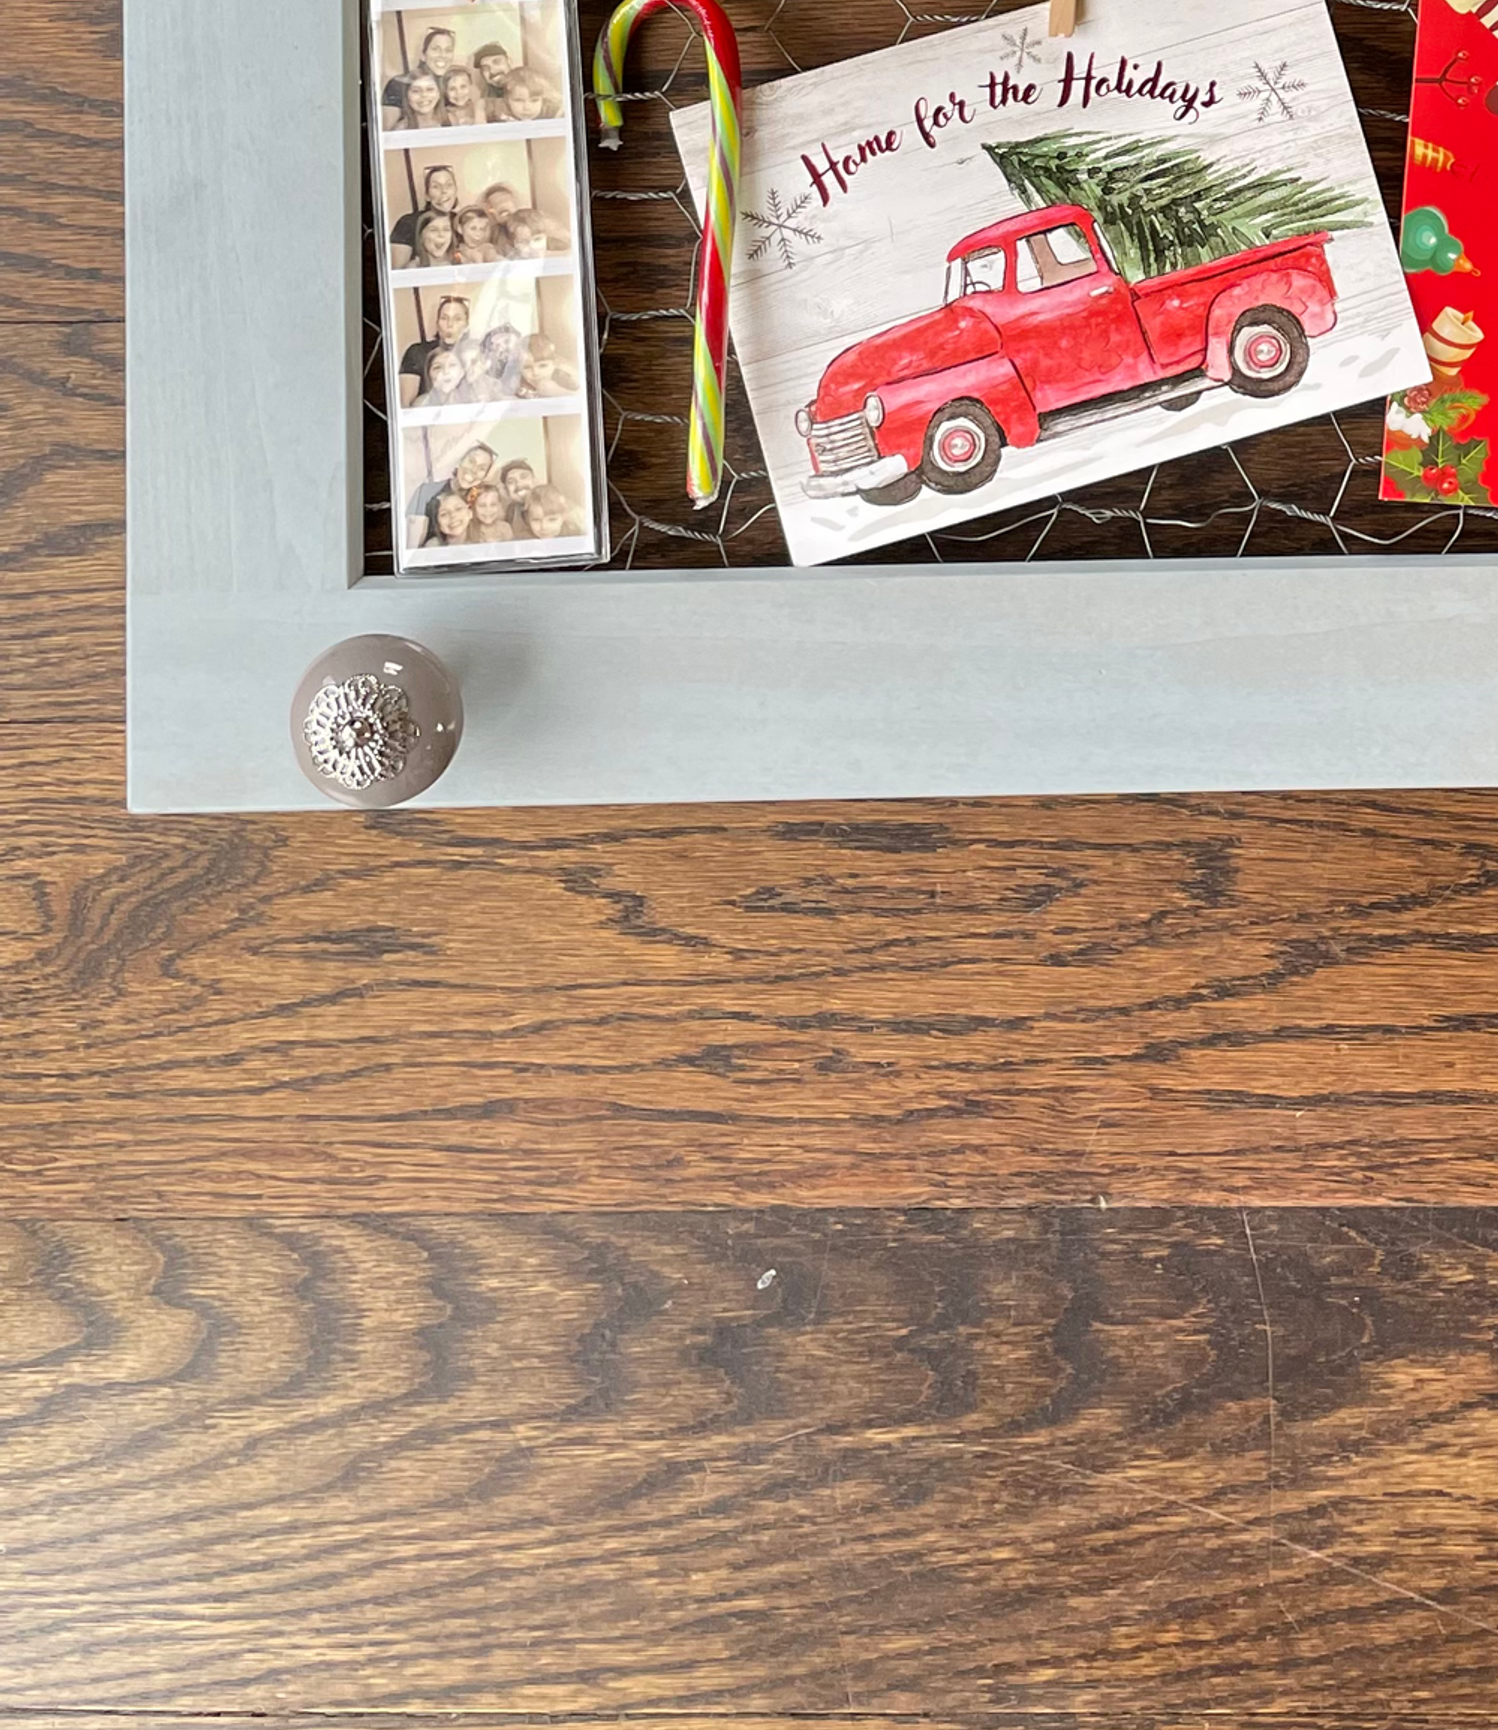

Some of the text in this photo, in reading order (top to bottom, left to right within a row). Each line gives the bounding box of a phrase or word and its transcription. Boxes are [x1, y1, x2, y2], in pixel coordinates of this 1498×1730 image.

[801, 51, 1224, 207] Home for the Holidays
